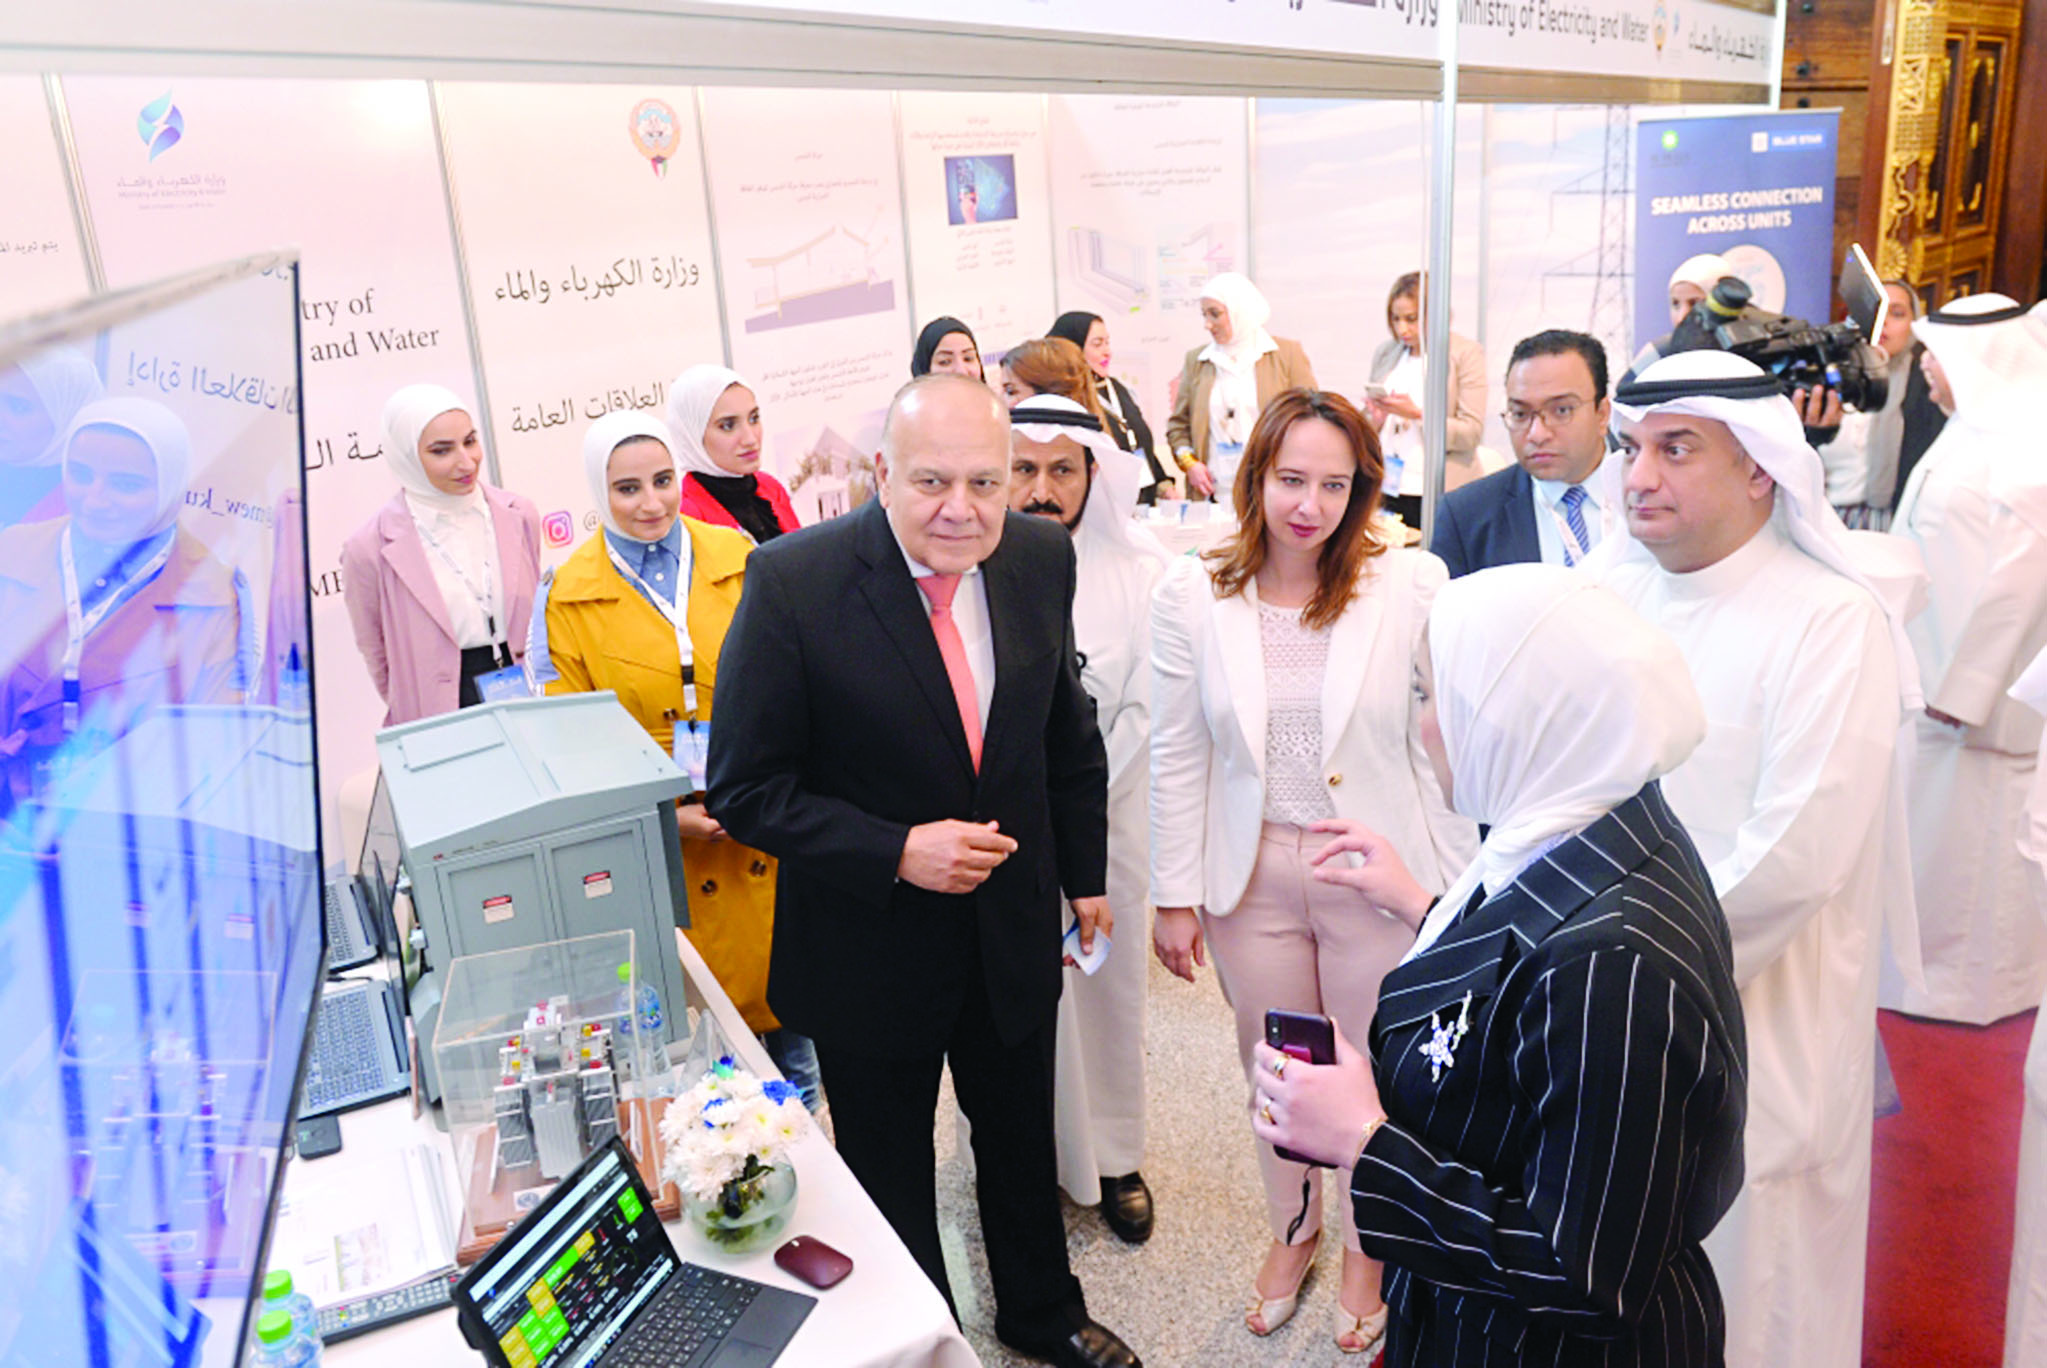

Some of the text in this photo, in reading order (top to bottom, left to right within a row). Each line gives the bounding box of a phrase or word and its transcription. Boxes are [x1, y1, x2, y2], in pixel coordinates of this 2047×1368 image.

[1520, 2, 1535, 29] of
[1538, 1, 1597, 44] Electricity
[1600, 11, 1619, 39] and
[1651, 187, 1823, 215] SEAMLESS CONNECTION
[1687, 209, 1792, 235] ACROSS UNITS
[494, 255, 699, 304] وزارة الكهرباء والماء
[349, 288, 375, 316] of
[310, 328, 440, 362] and Water
[510, 381, 665, 433] العلاقات العامة
